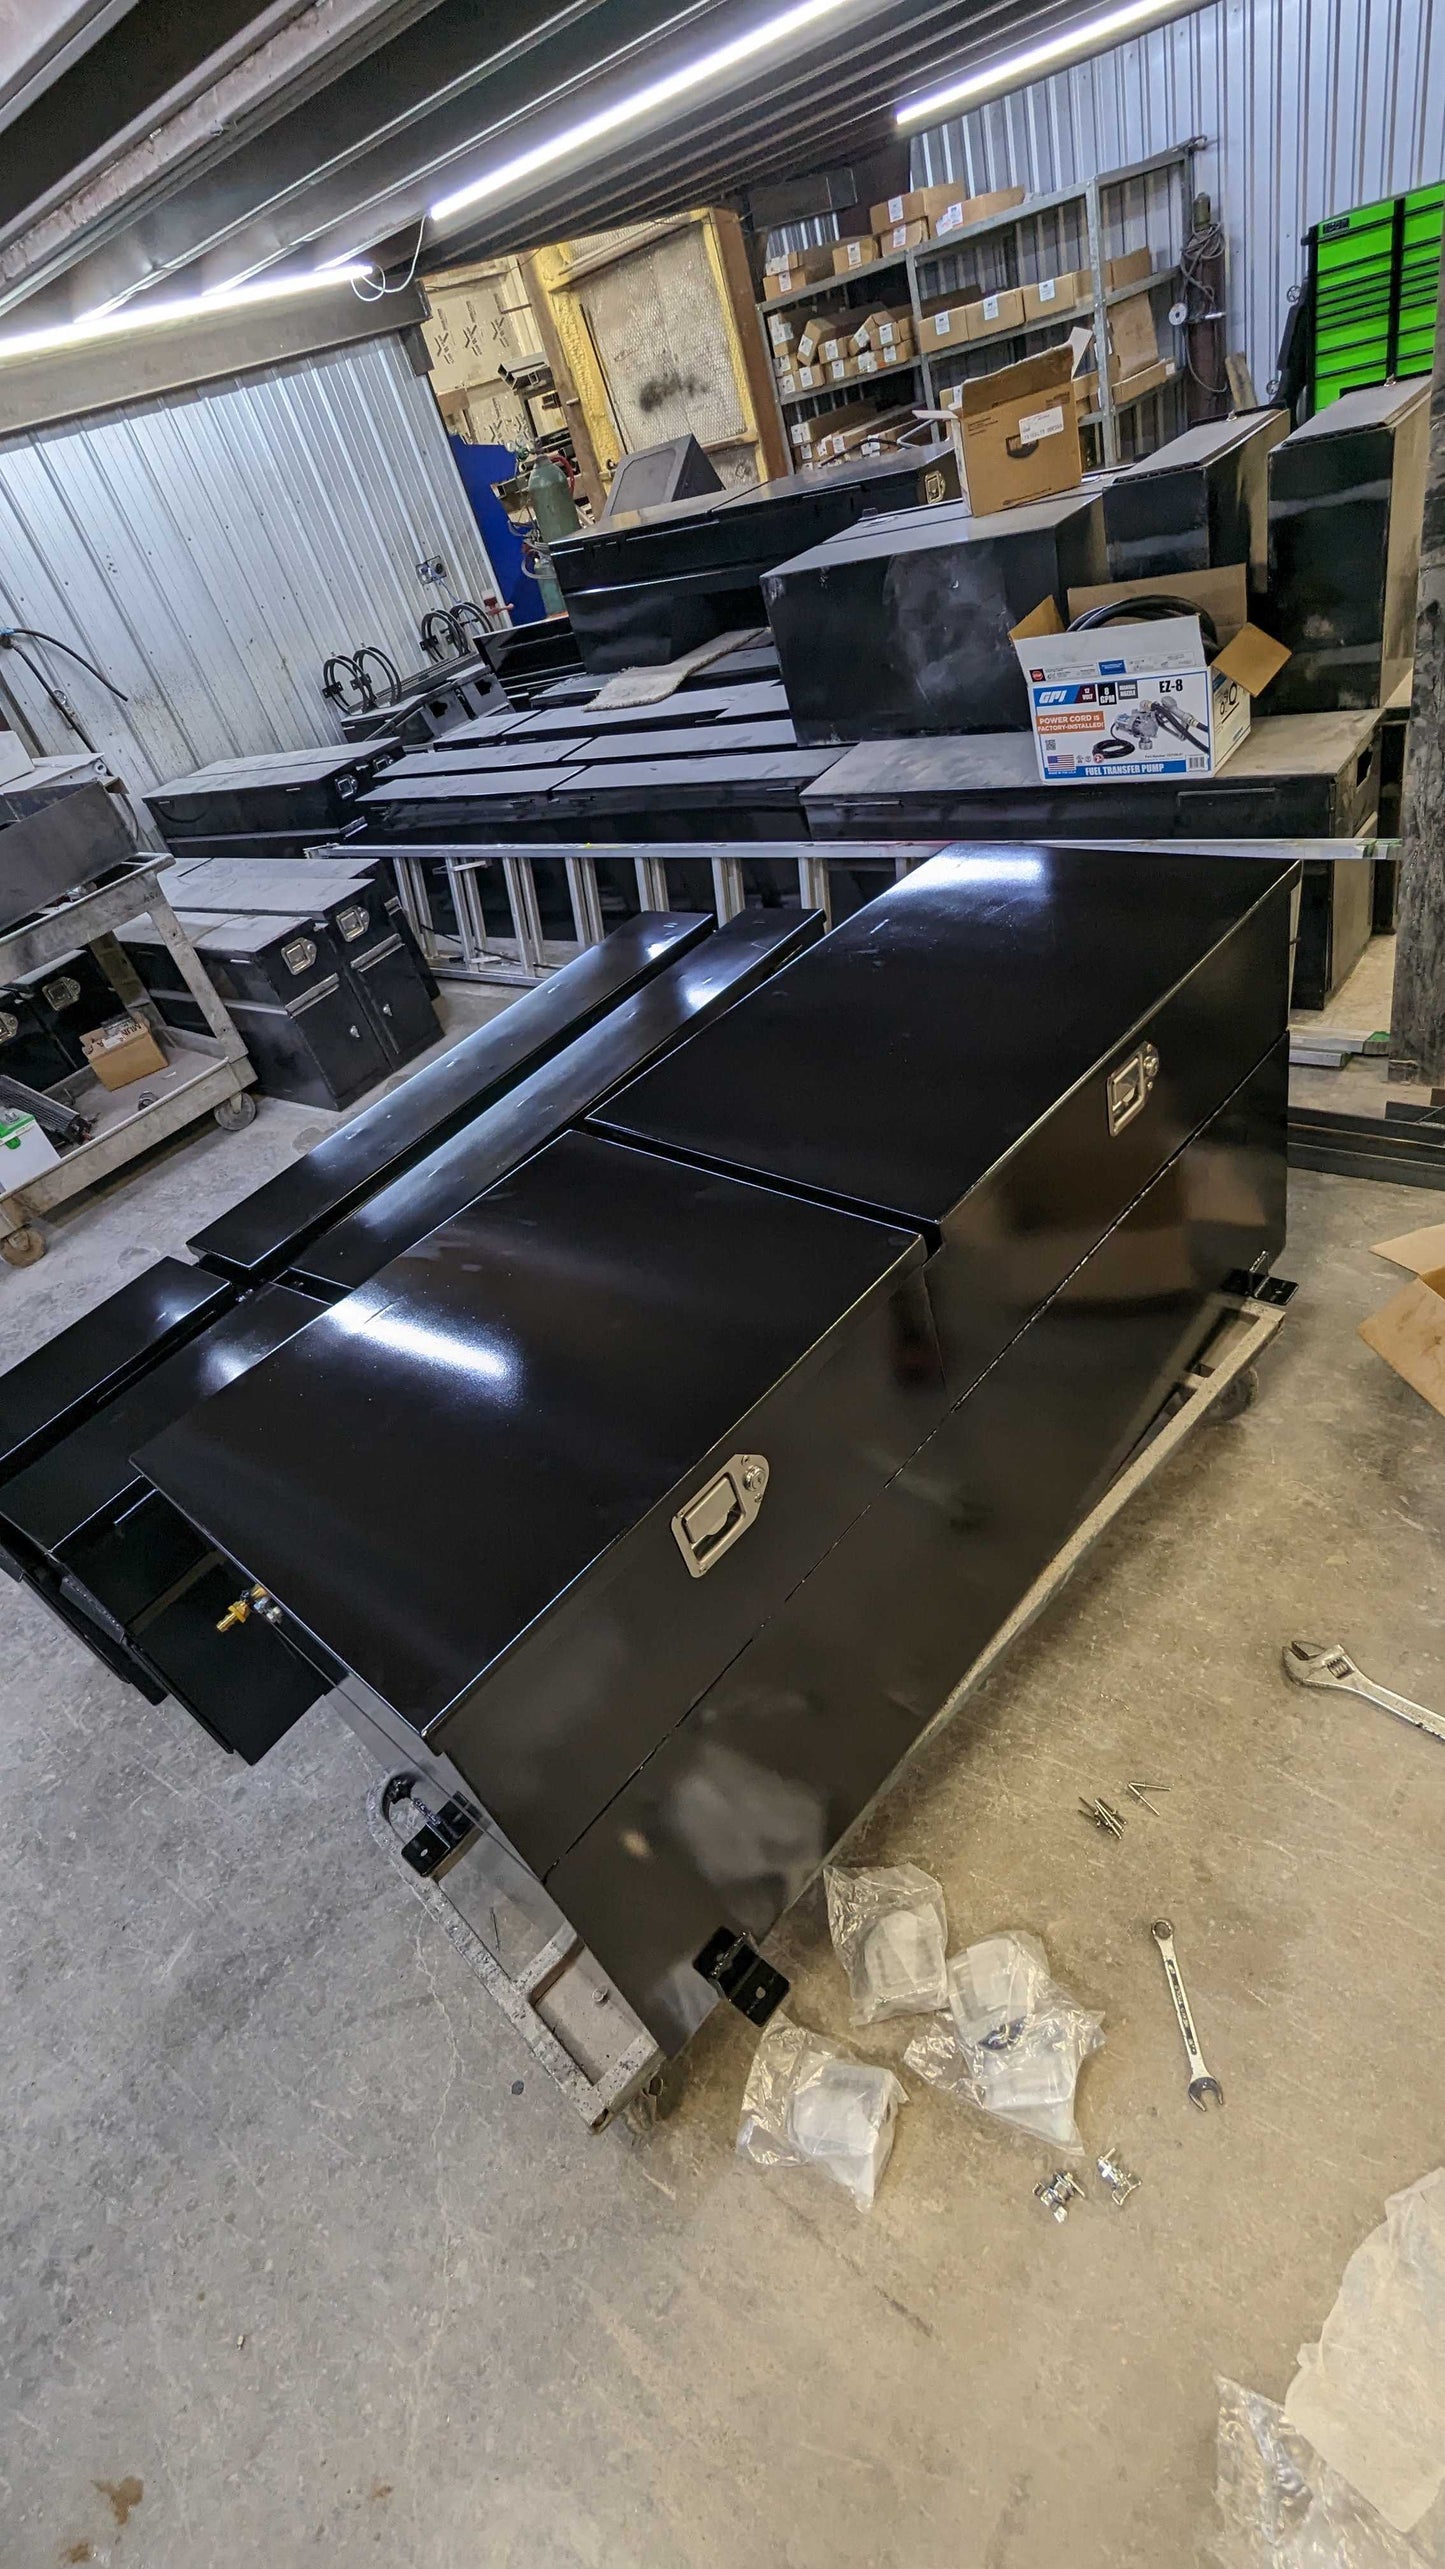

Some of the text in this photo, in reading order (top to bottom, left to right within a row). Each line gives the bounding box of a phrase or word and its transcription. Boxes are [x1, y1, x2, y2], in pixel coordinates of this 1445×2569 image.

[1159, 679, 1183, 693] EZ-8
[1039, 690, 1067, 704] GPI
[1100, 694, 1115, 704] GPM
[1040, 716, 1068, 724] POWER
[1069, 714, 1092, 722] CORD
[1085, 766, 1102, 776] FUEL
[1103, 764, 1140, 775] TRANSFER
[1142, 763, 1164, 774] PUMP
